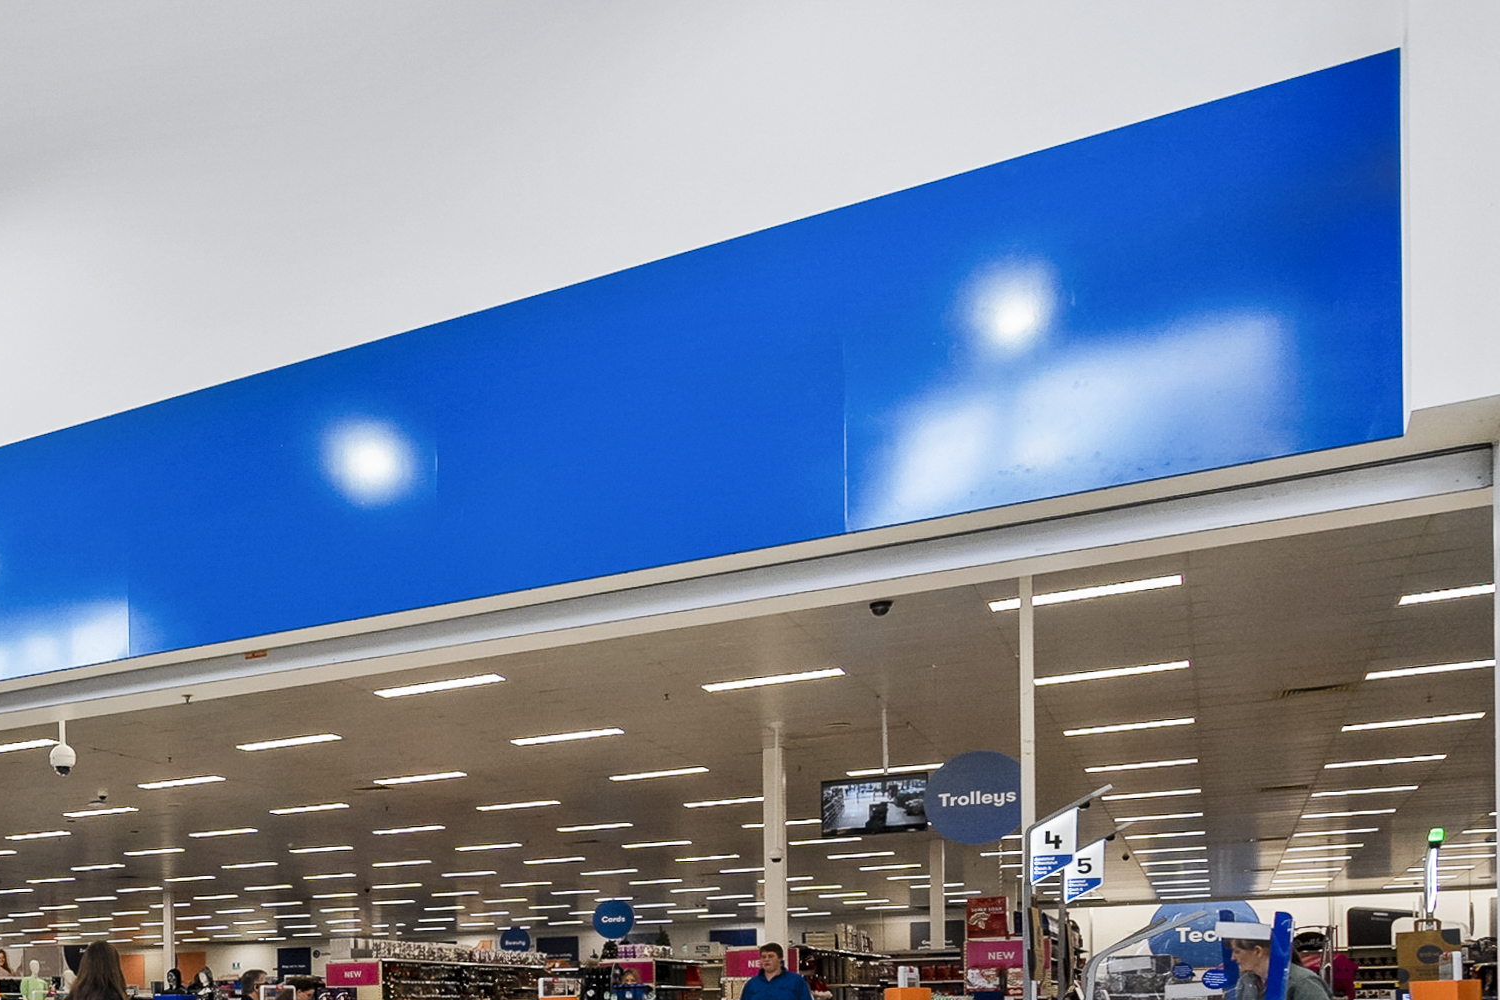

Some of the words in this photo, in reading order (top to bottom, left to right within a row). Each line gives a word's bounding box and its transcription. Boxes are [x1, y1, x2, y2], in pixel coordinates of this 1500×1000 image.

[938, 790, 1016, 807] Trolleys
[1045, 831, 1062, 849] 4
[1078, 858, 1092, 874] 5
[1175, 927, 1222, 942] Tec
[988, 951, 1015, 960] NEW
